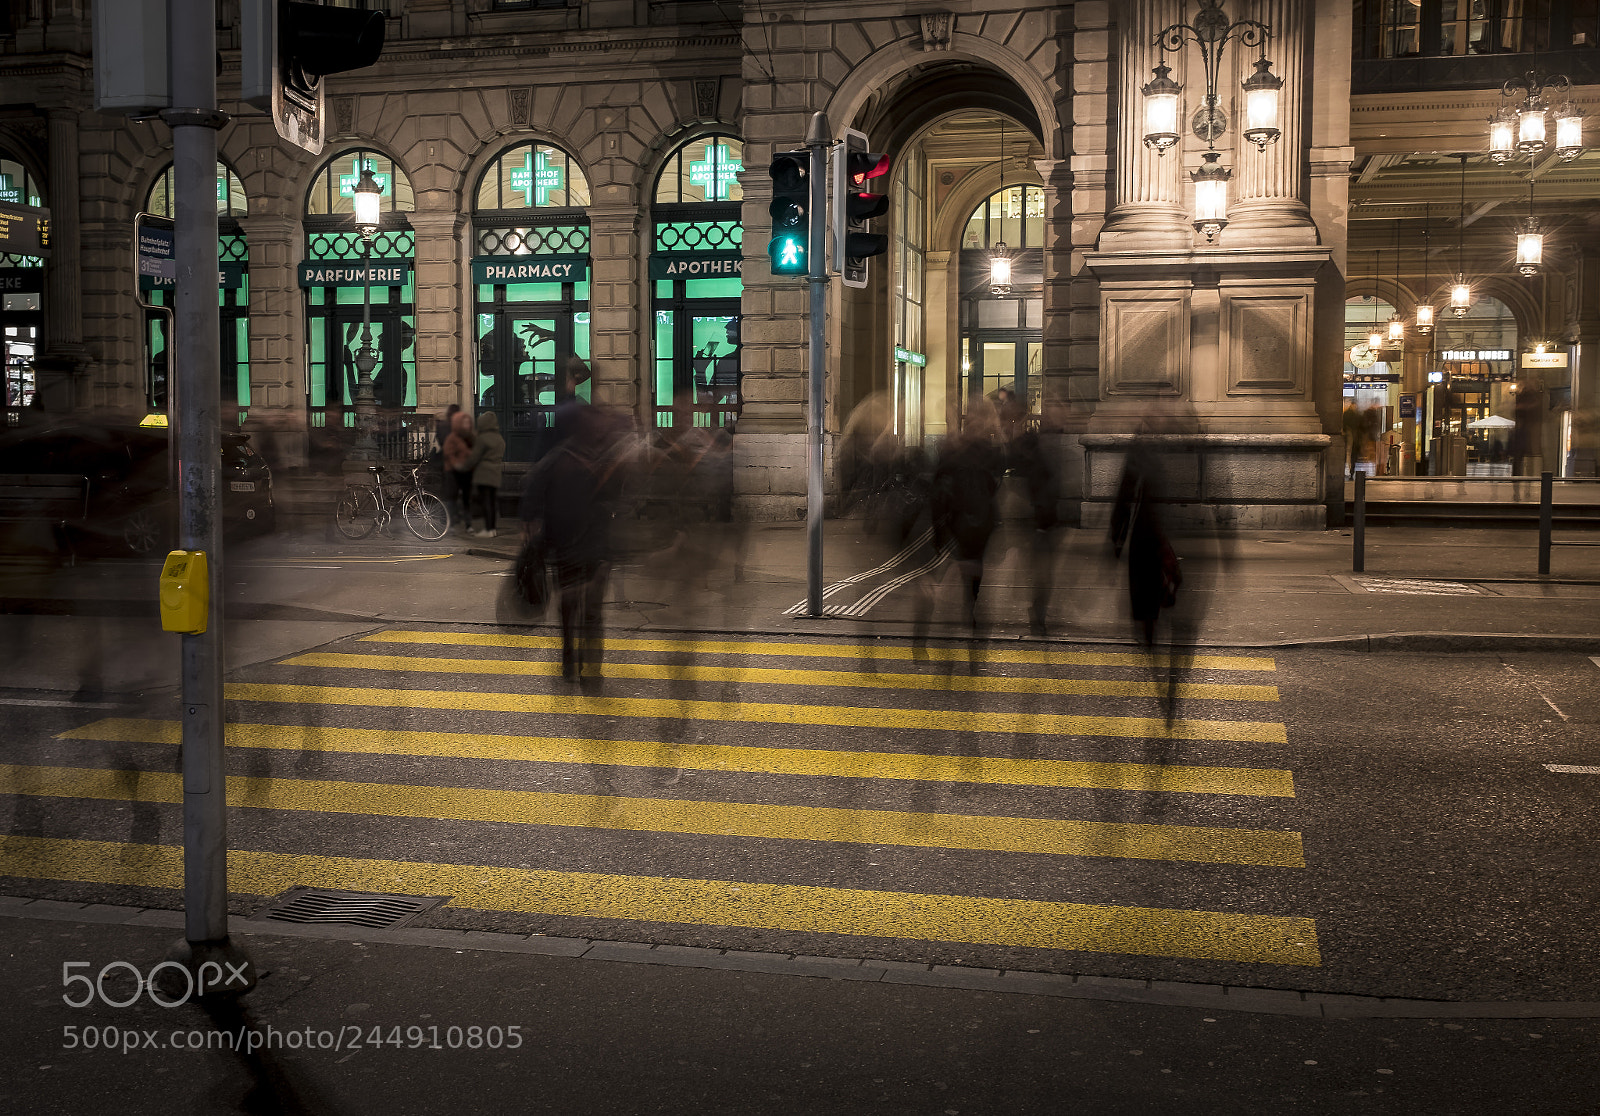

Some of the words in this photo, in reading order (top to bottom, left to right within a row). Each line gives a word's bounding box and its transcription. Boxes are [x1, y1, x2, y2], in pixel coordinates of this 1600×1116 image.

[691, 164, 741, 172] BAHNHOF
[512, 171, 559, 179] BAHNHOF
[691, 172, 737, 181] APOTHEK
[341, 177, 385, 186] BAHOF
[486, 264, 572, 279] PHARMACY
[666, 260, 743, 274] APOTHEK
[305, 268, 402, 282] PARFUMERIE
